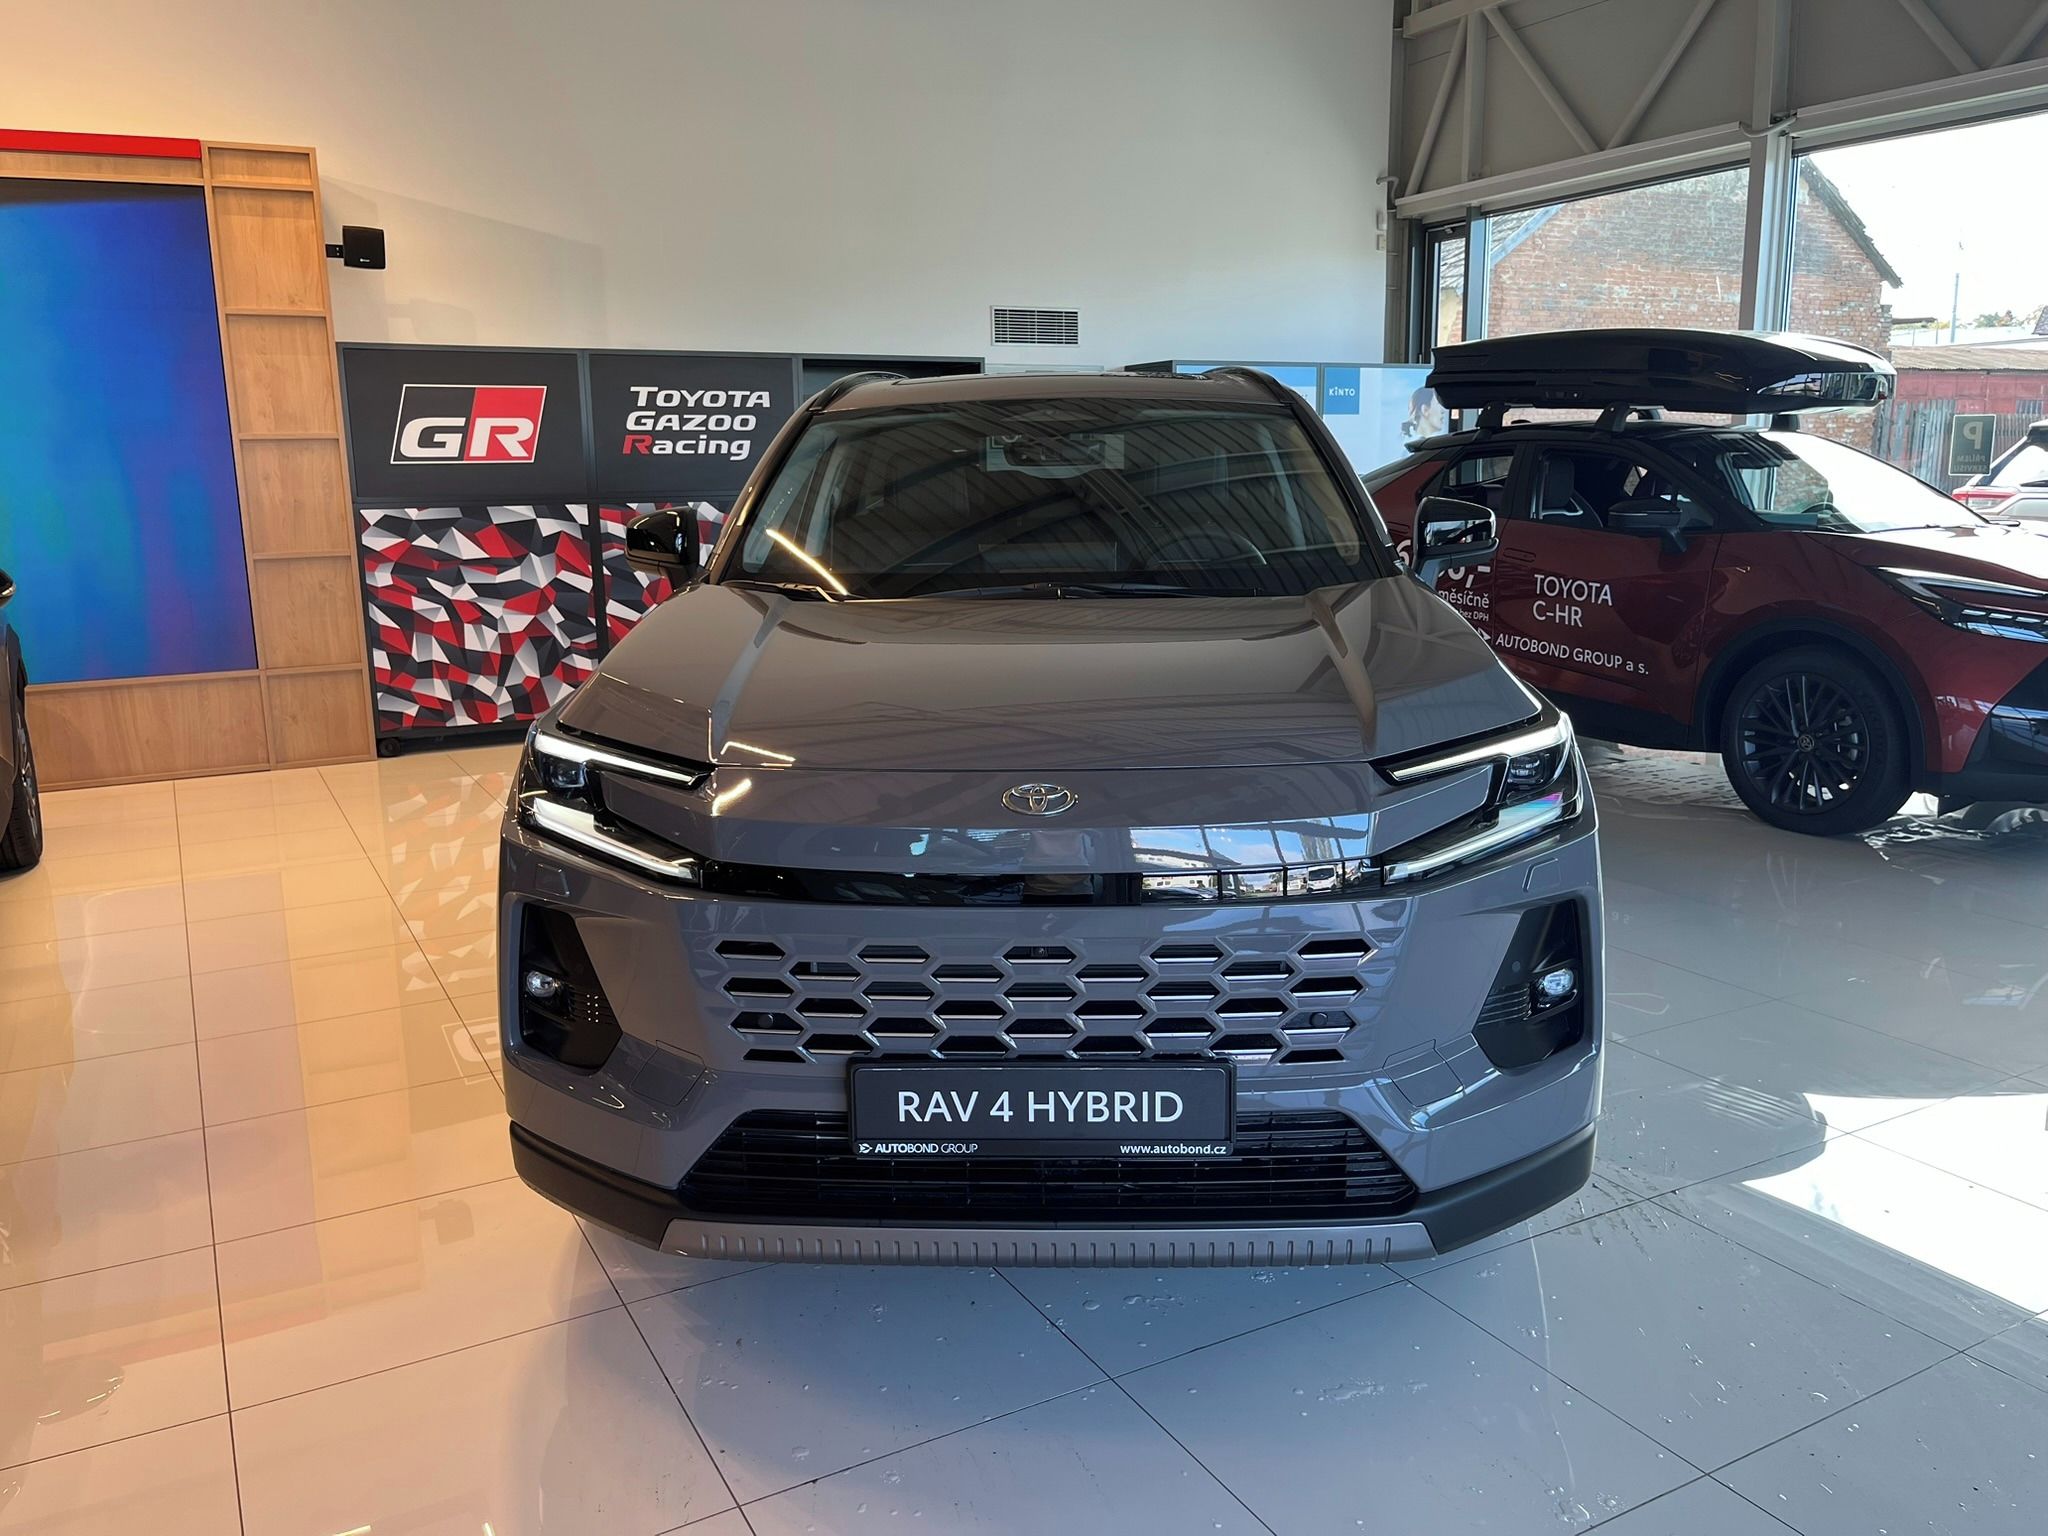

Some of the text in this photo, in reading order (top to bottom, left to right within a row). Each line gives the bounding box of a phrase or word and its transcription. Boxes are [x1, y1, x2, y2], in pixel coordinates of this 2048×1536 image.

[630, 386, 771, 408] TOYOTA
[626, 410, 757, 431] GAZOO
[400, 417, 535, 458] GR
[622, 434, 751, 461] Racing
[1534, 574, 1613, 606] TOYOTA
[1473, 610, 1490, 622] DPH
[1533, 600, 1583, 628] C-HR
[1495, 633, 1649, 675] AUTOBOND GROUP a s.
[898, 1090, 1184, 1123] RAV 4 HYBRID
[874, 1143, 978, 1154] AUTOBOND GROUP
[1120, 1142, 1227, 1155] www.autobond.cz
